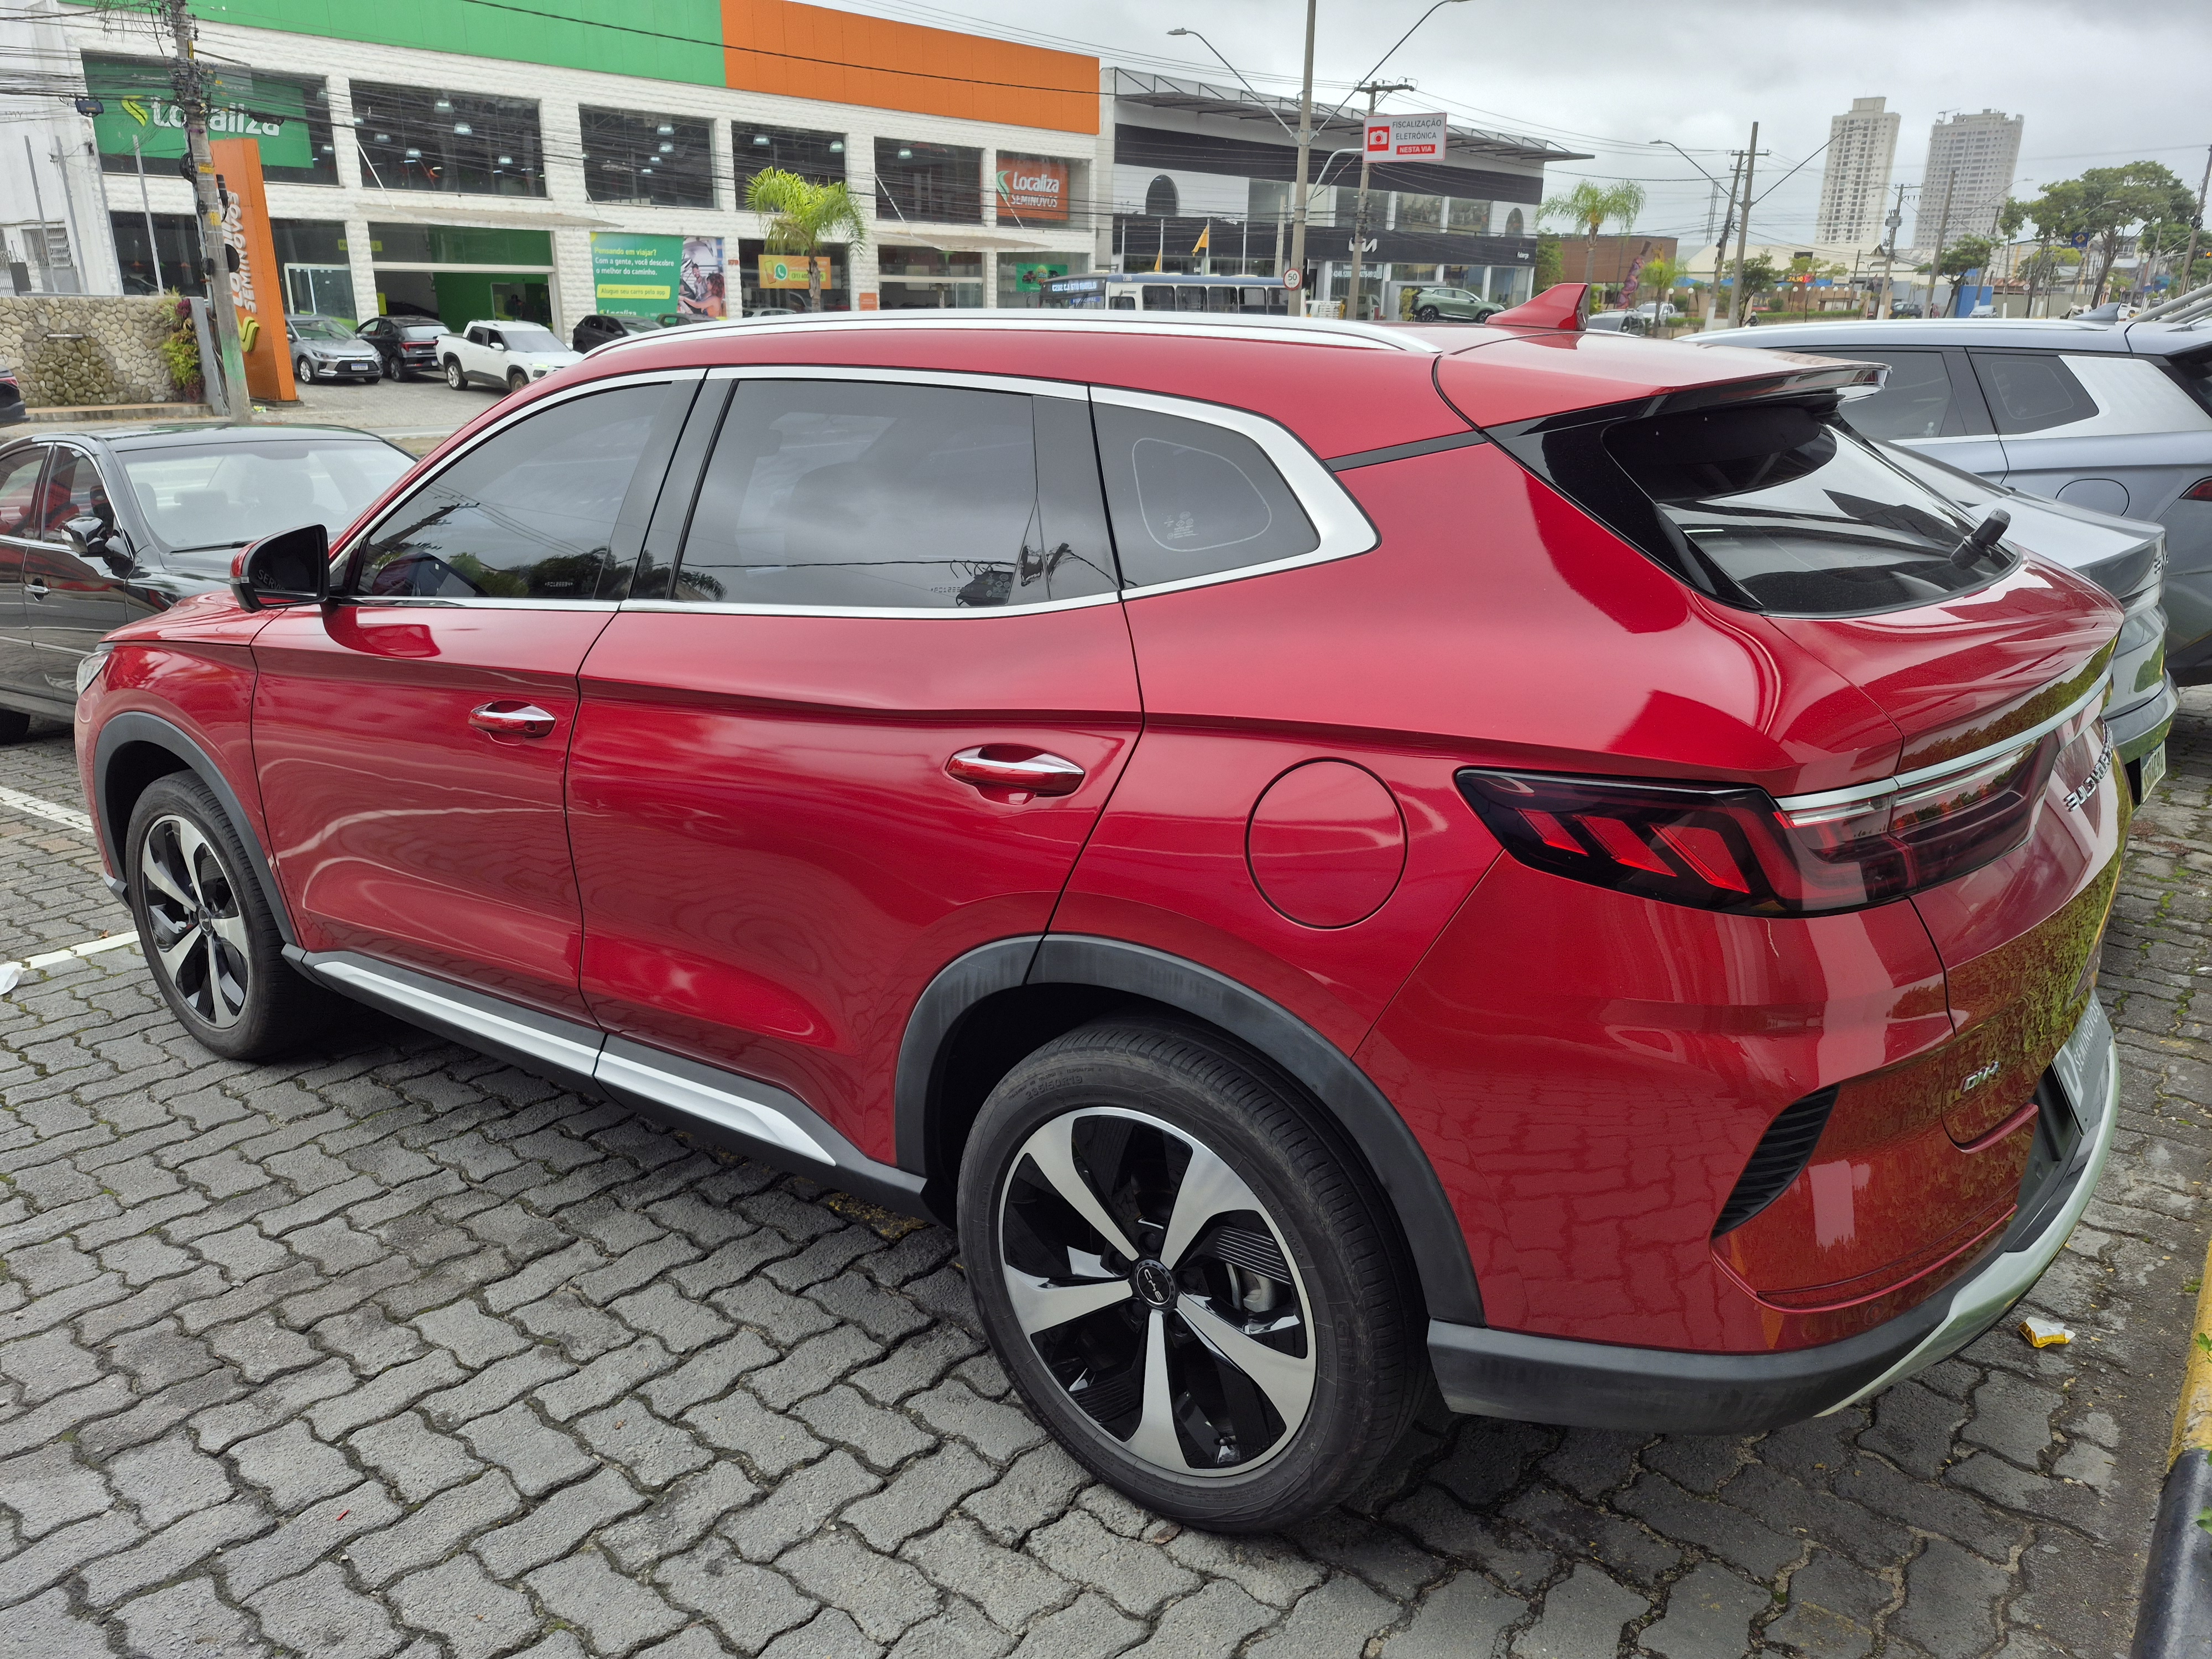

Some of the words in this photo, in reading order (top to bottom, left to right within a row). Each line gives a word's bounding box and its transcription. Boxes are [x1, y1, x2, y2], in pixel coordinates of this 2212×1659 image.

[150, 96, 280, 137] Loaliza
[1392, 118, 1442, 129] FISCALIZAÇÃO
[1396, 131, 1437, 140] ELETRÔNICA
[1013, 171, 1060, 193] Localiza
[1010, 194, 1058, 207] SEMINOVOS
[227, 191, 257, 314] SEMINOVOS
[636, 249, 657, 257] viajar?
[2074, 999, 2100, 1072] SEMINOVOS
[1025, 1074, 1083, 1099] 235/50R19
